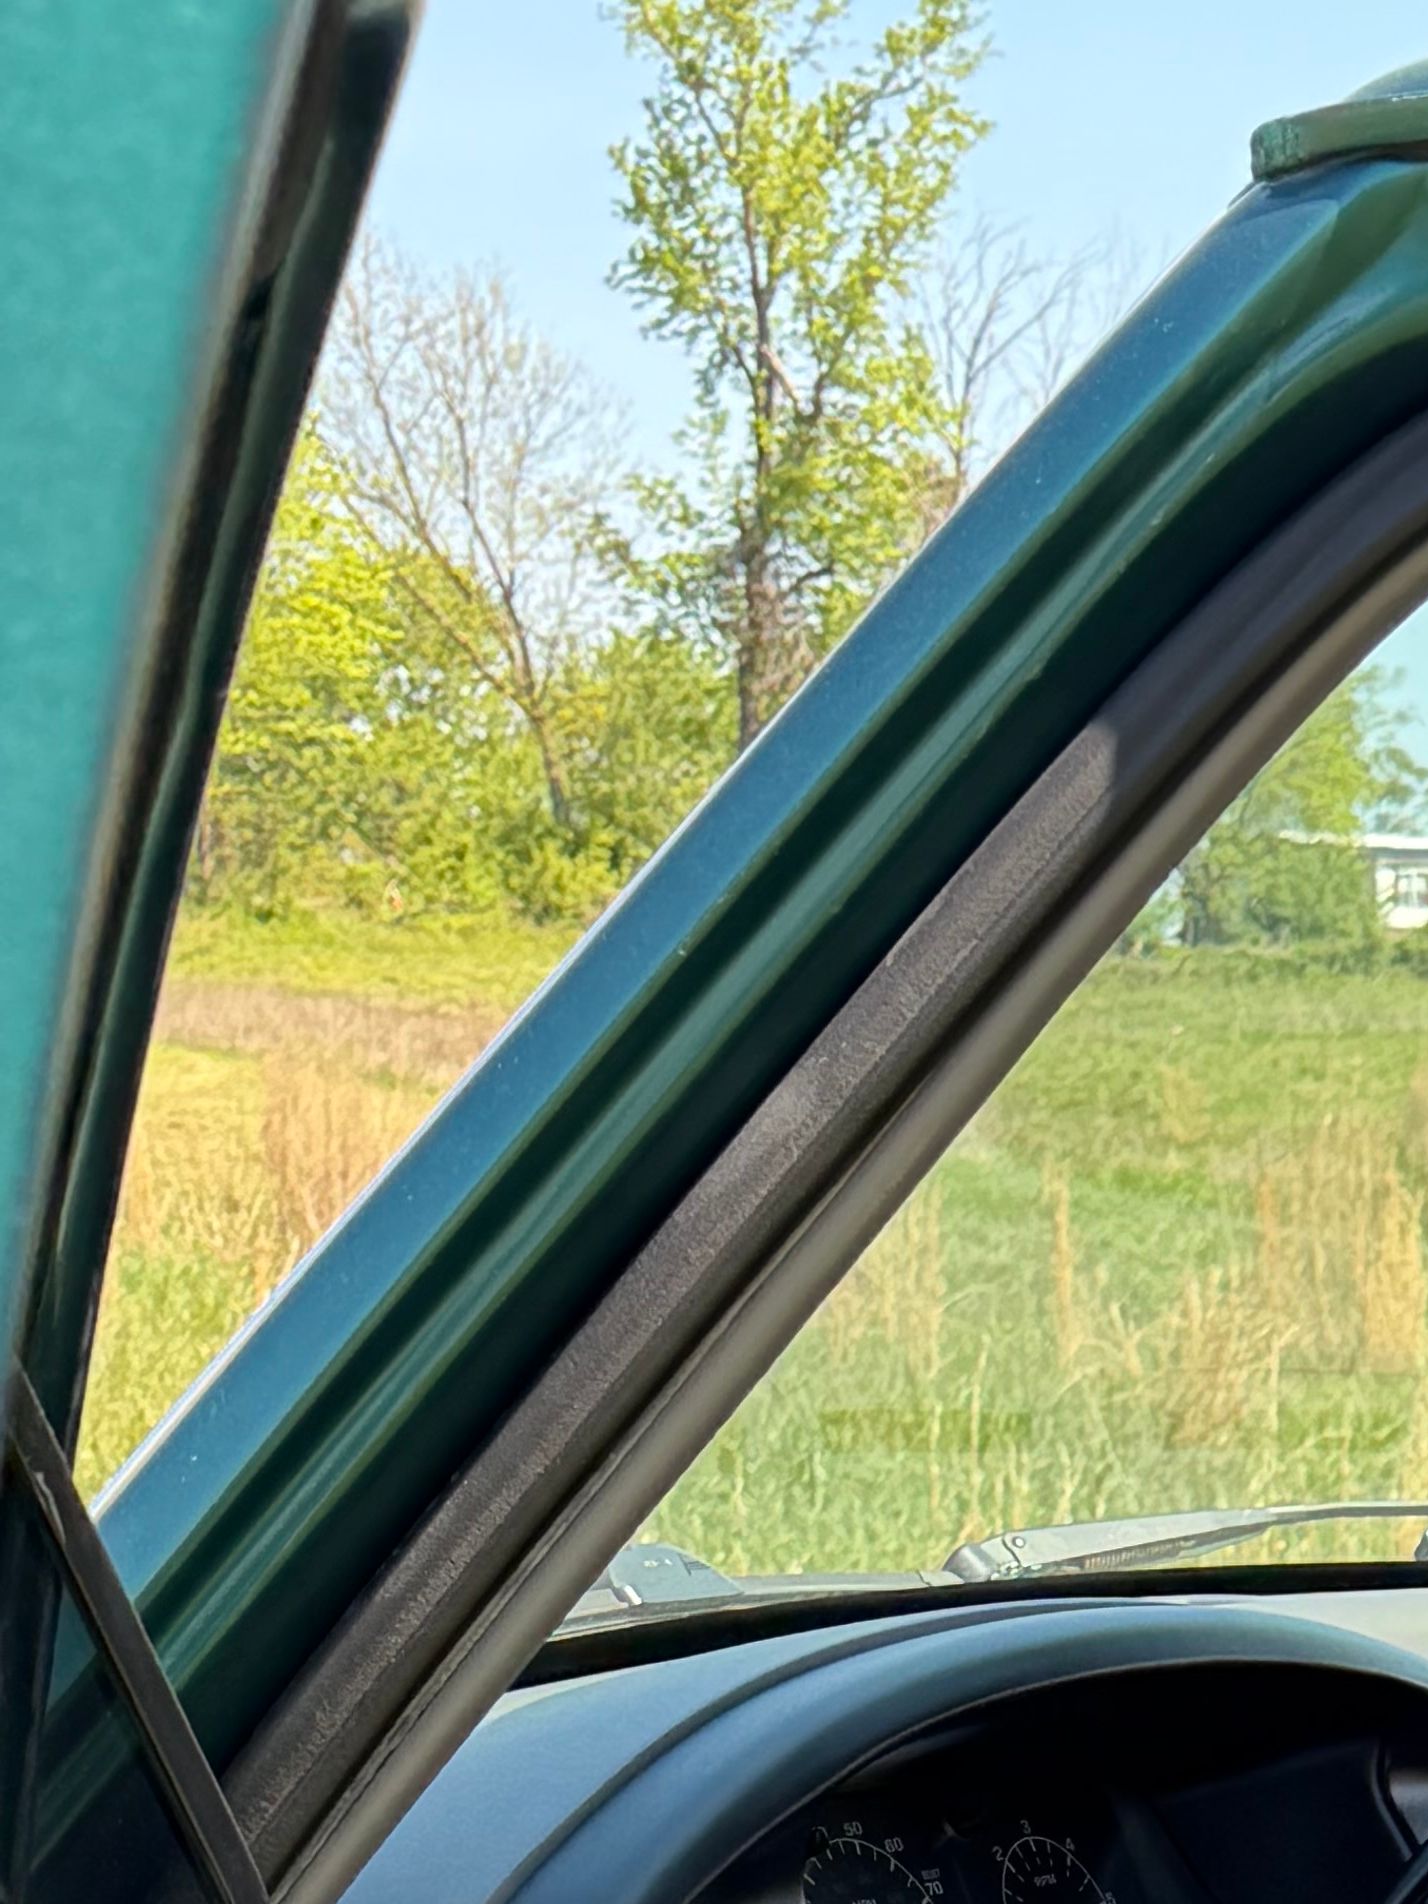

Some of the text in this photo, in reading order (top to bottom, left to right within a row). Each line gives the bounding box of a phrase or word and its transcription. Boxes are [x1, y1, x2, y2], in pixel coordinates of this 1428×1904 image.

[843, 1821, 863, 1836] 50
[1020, 1819, 1031, 1834] 3
[884, 1837, 904, 1853] 60
[1066, 1838, 1075, 1851] 4
[992, 1846, 1004, 1861] 2
[924, 1880, 944, 1896] 70
